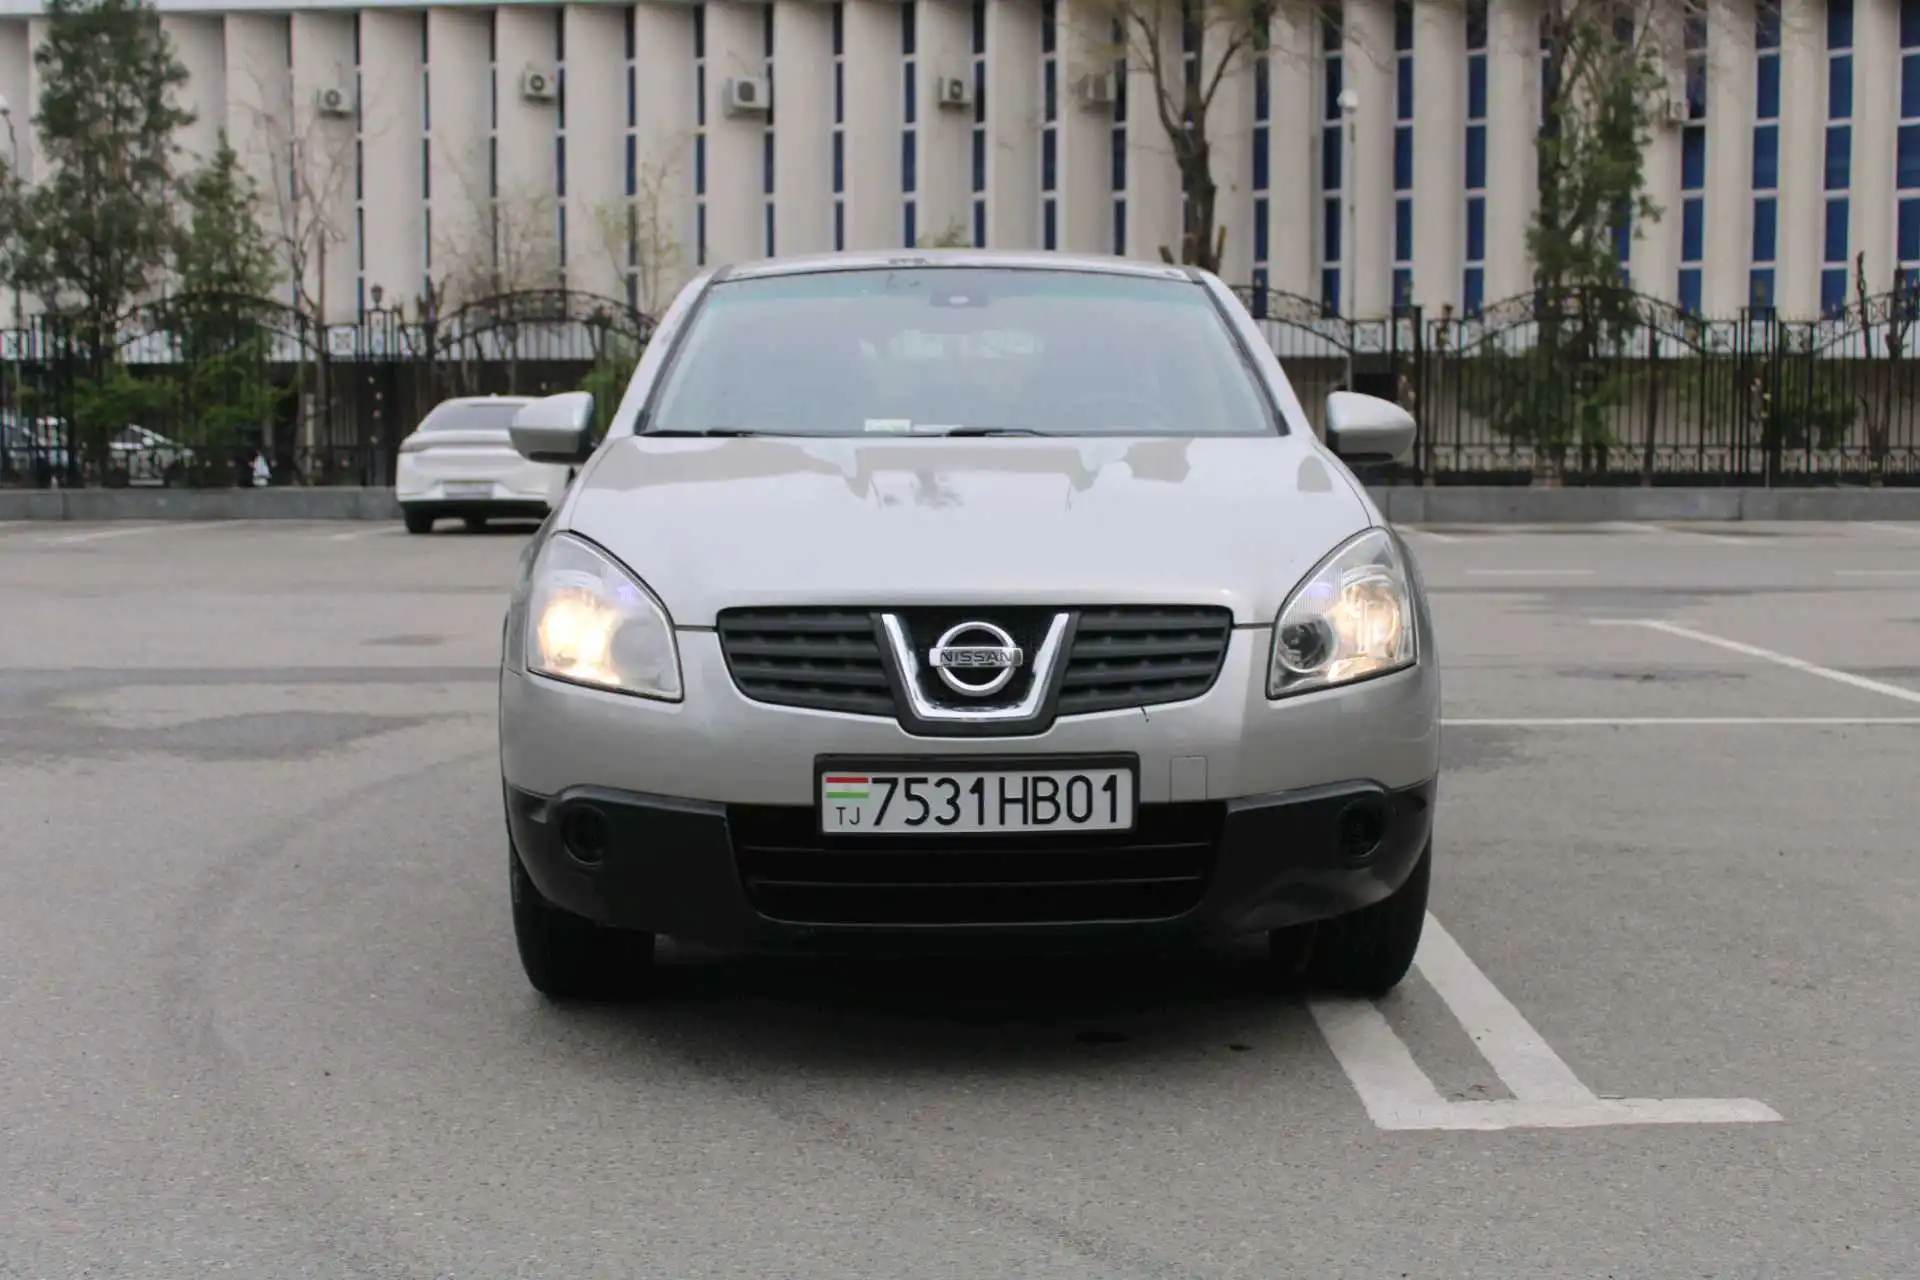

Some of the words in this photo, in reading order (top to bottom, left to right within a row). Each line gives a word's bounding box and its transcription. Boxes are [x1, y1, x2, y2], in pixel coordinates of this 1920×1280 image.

[941, 651, 1013, 662] NISSAN
[871, 774, 1117, 826] 7531HB01
[835, 806, 861, 825] TJ
